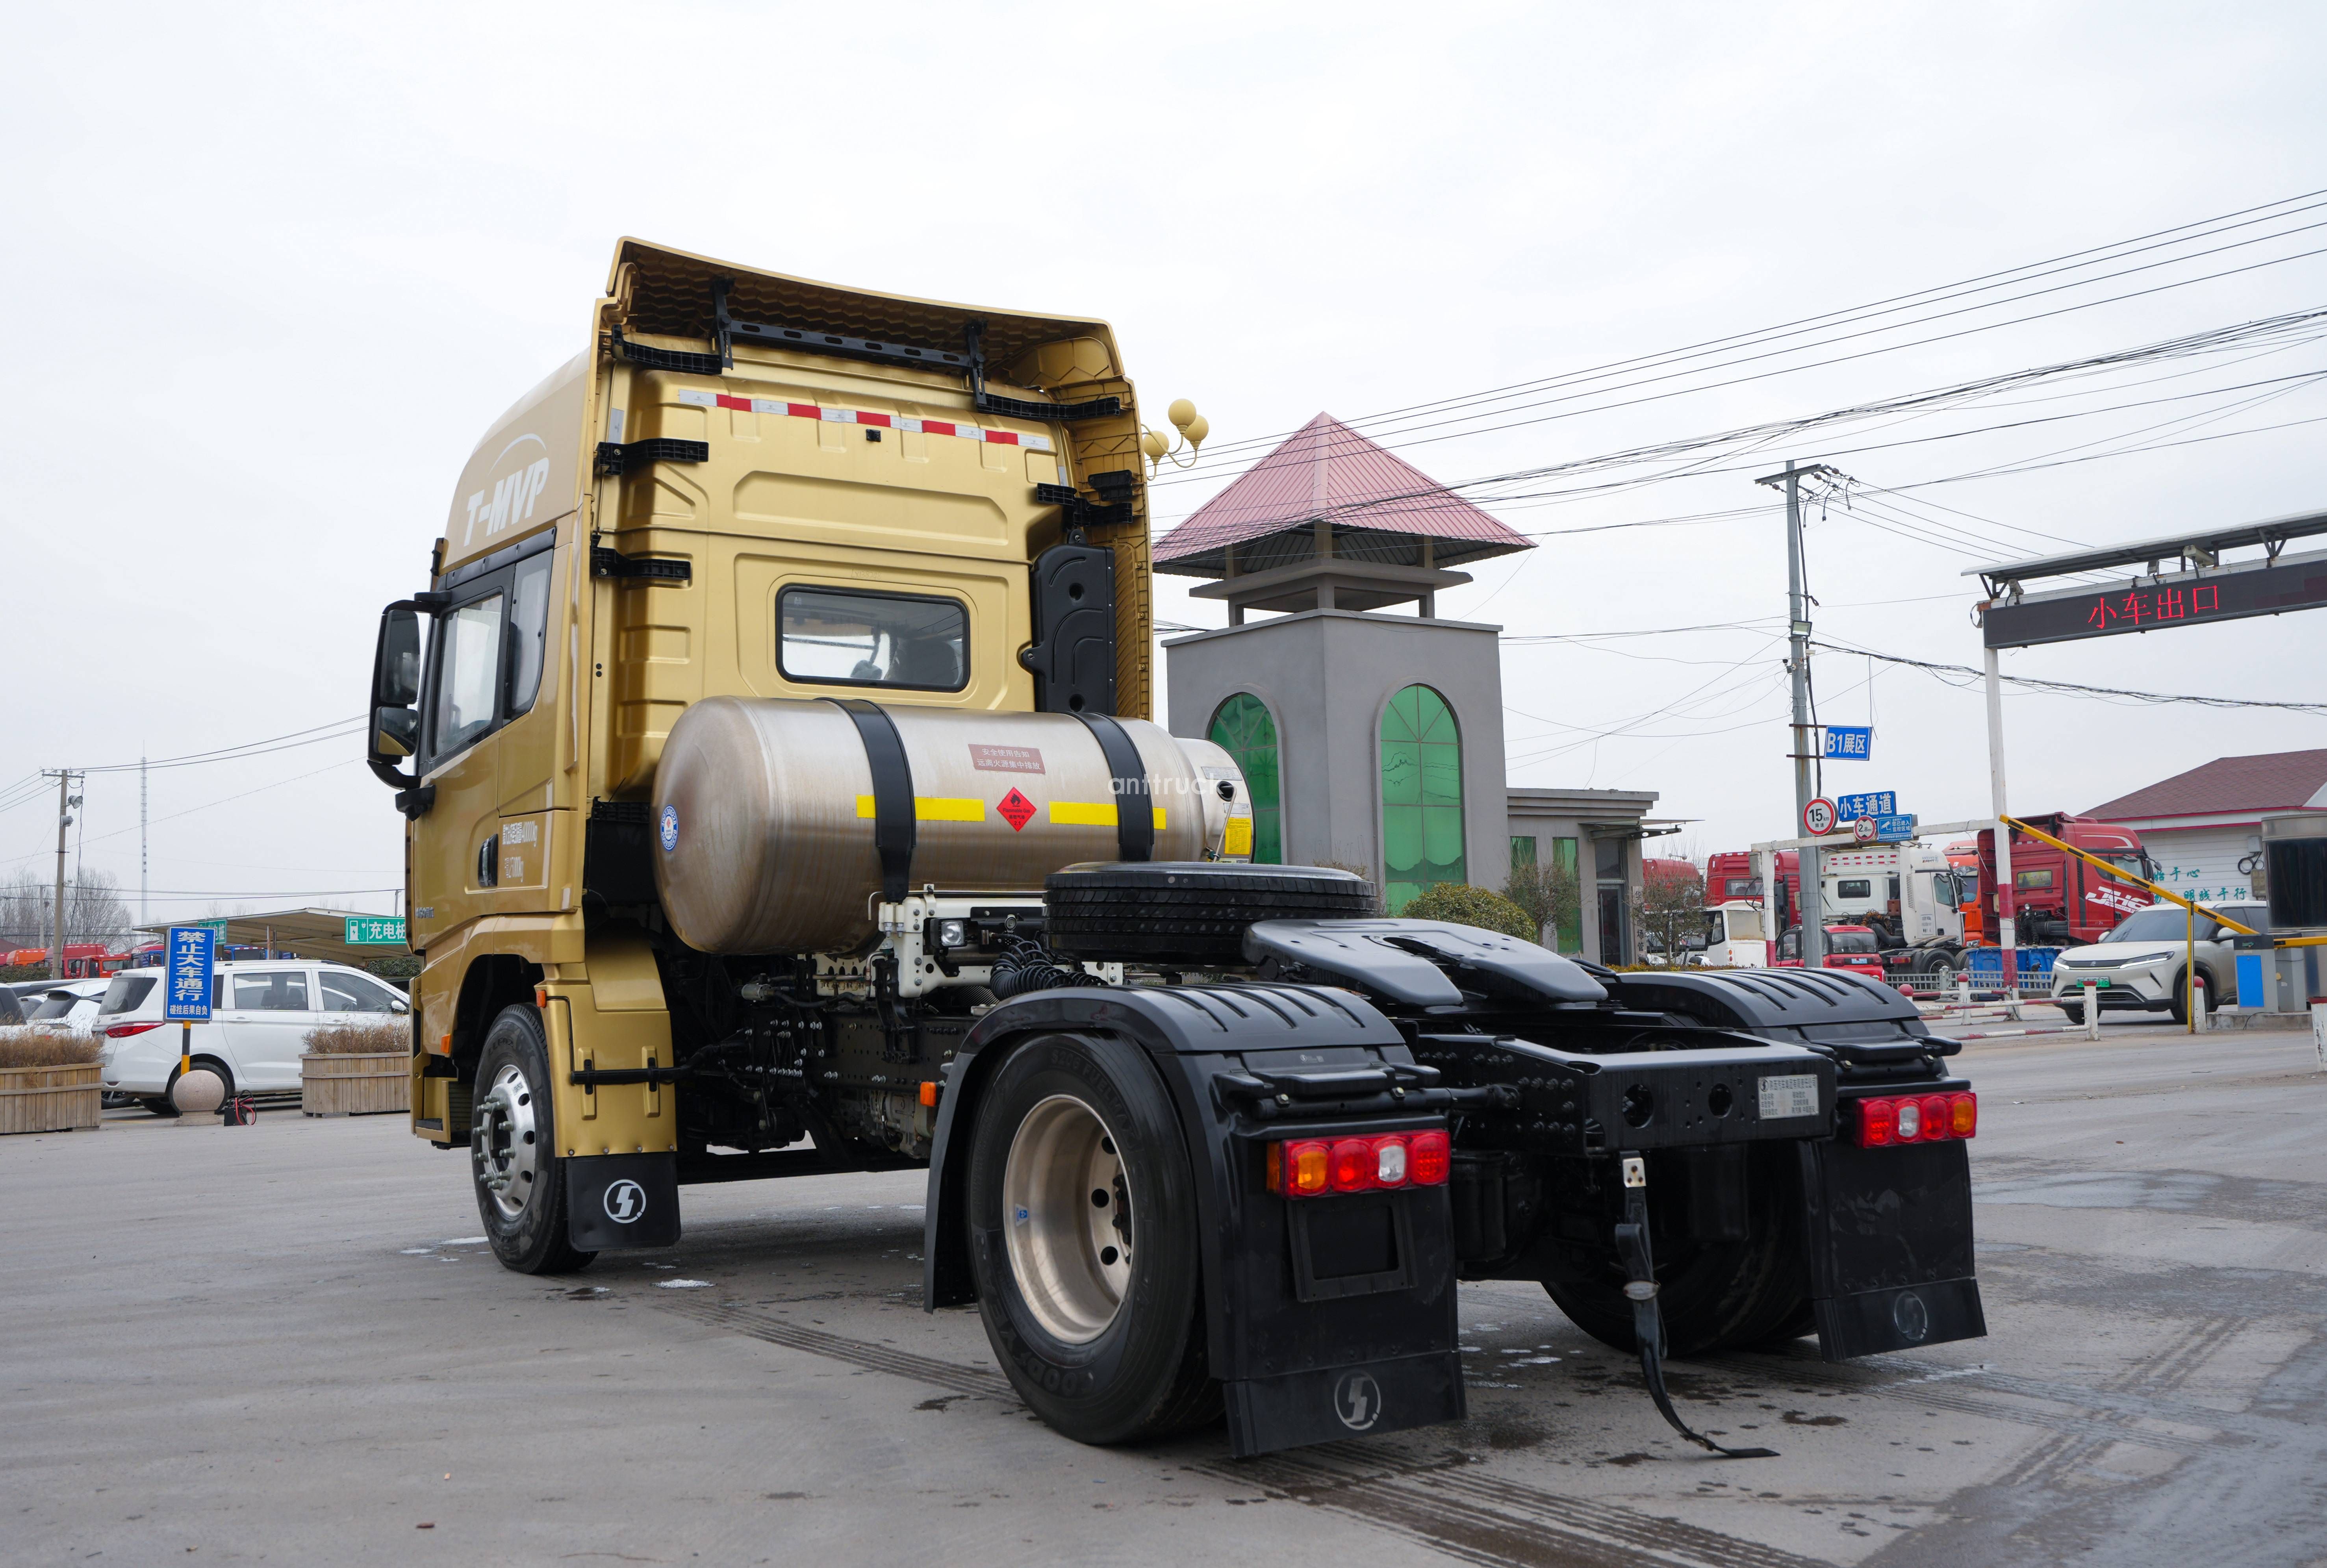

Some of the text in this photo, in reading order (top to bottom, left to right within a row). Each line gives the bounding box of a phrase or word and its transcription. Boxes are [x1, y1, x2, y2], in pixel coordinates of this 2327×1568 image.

[464, 457, 549, 547] T-MVP
[2088, 585, 2219, 629] 小车出口
[982, 748, 1030, 758] 安全使用告知
[1826, 733, 1865, 754] B1展区
[977, 758, 1041, 770] 远离火源集中排放
[1839, 793, 1893, 818] 小车通道
[174, 931, 206, 1001] 禁止大车通行
[169, 1005, 208, 1015] 碰挂后果自负
